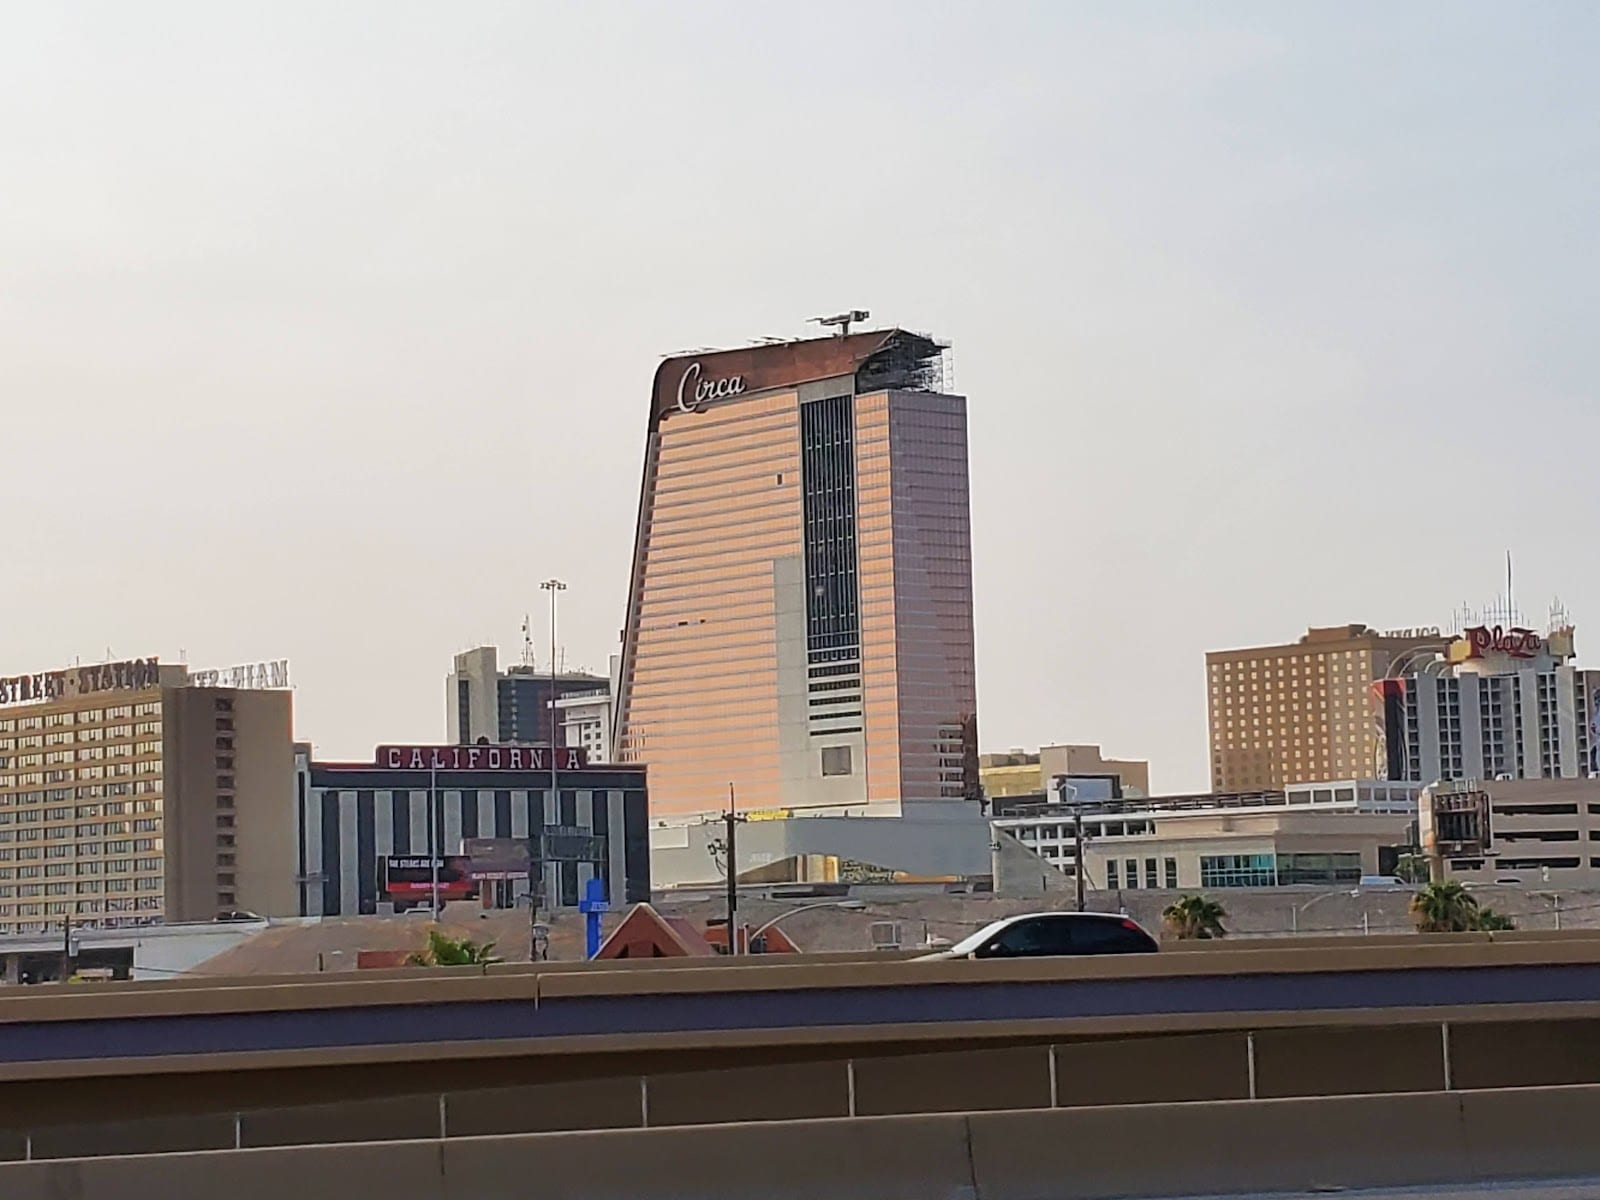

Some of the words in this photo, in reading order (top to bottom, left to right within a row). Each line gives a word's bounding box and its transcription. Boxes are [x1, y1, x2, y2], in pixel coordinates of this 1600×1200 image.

[677, 362, 746, 412] Circa
[79, 656, 159, 694] STATION
[388, 748, 580, 769] CALIFORNA
